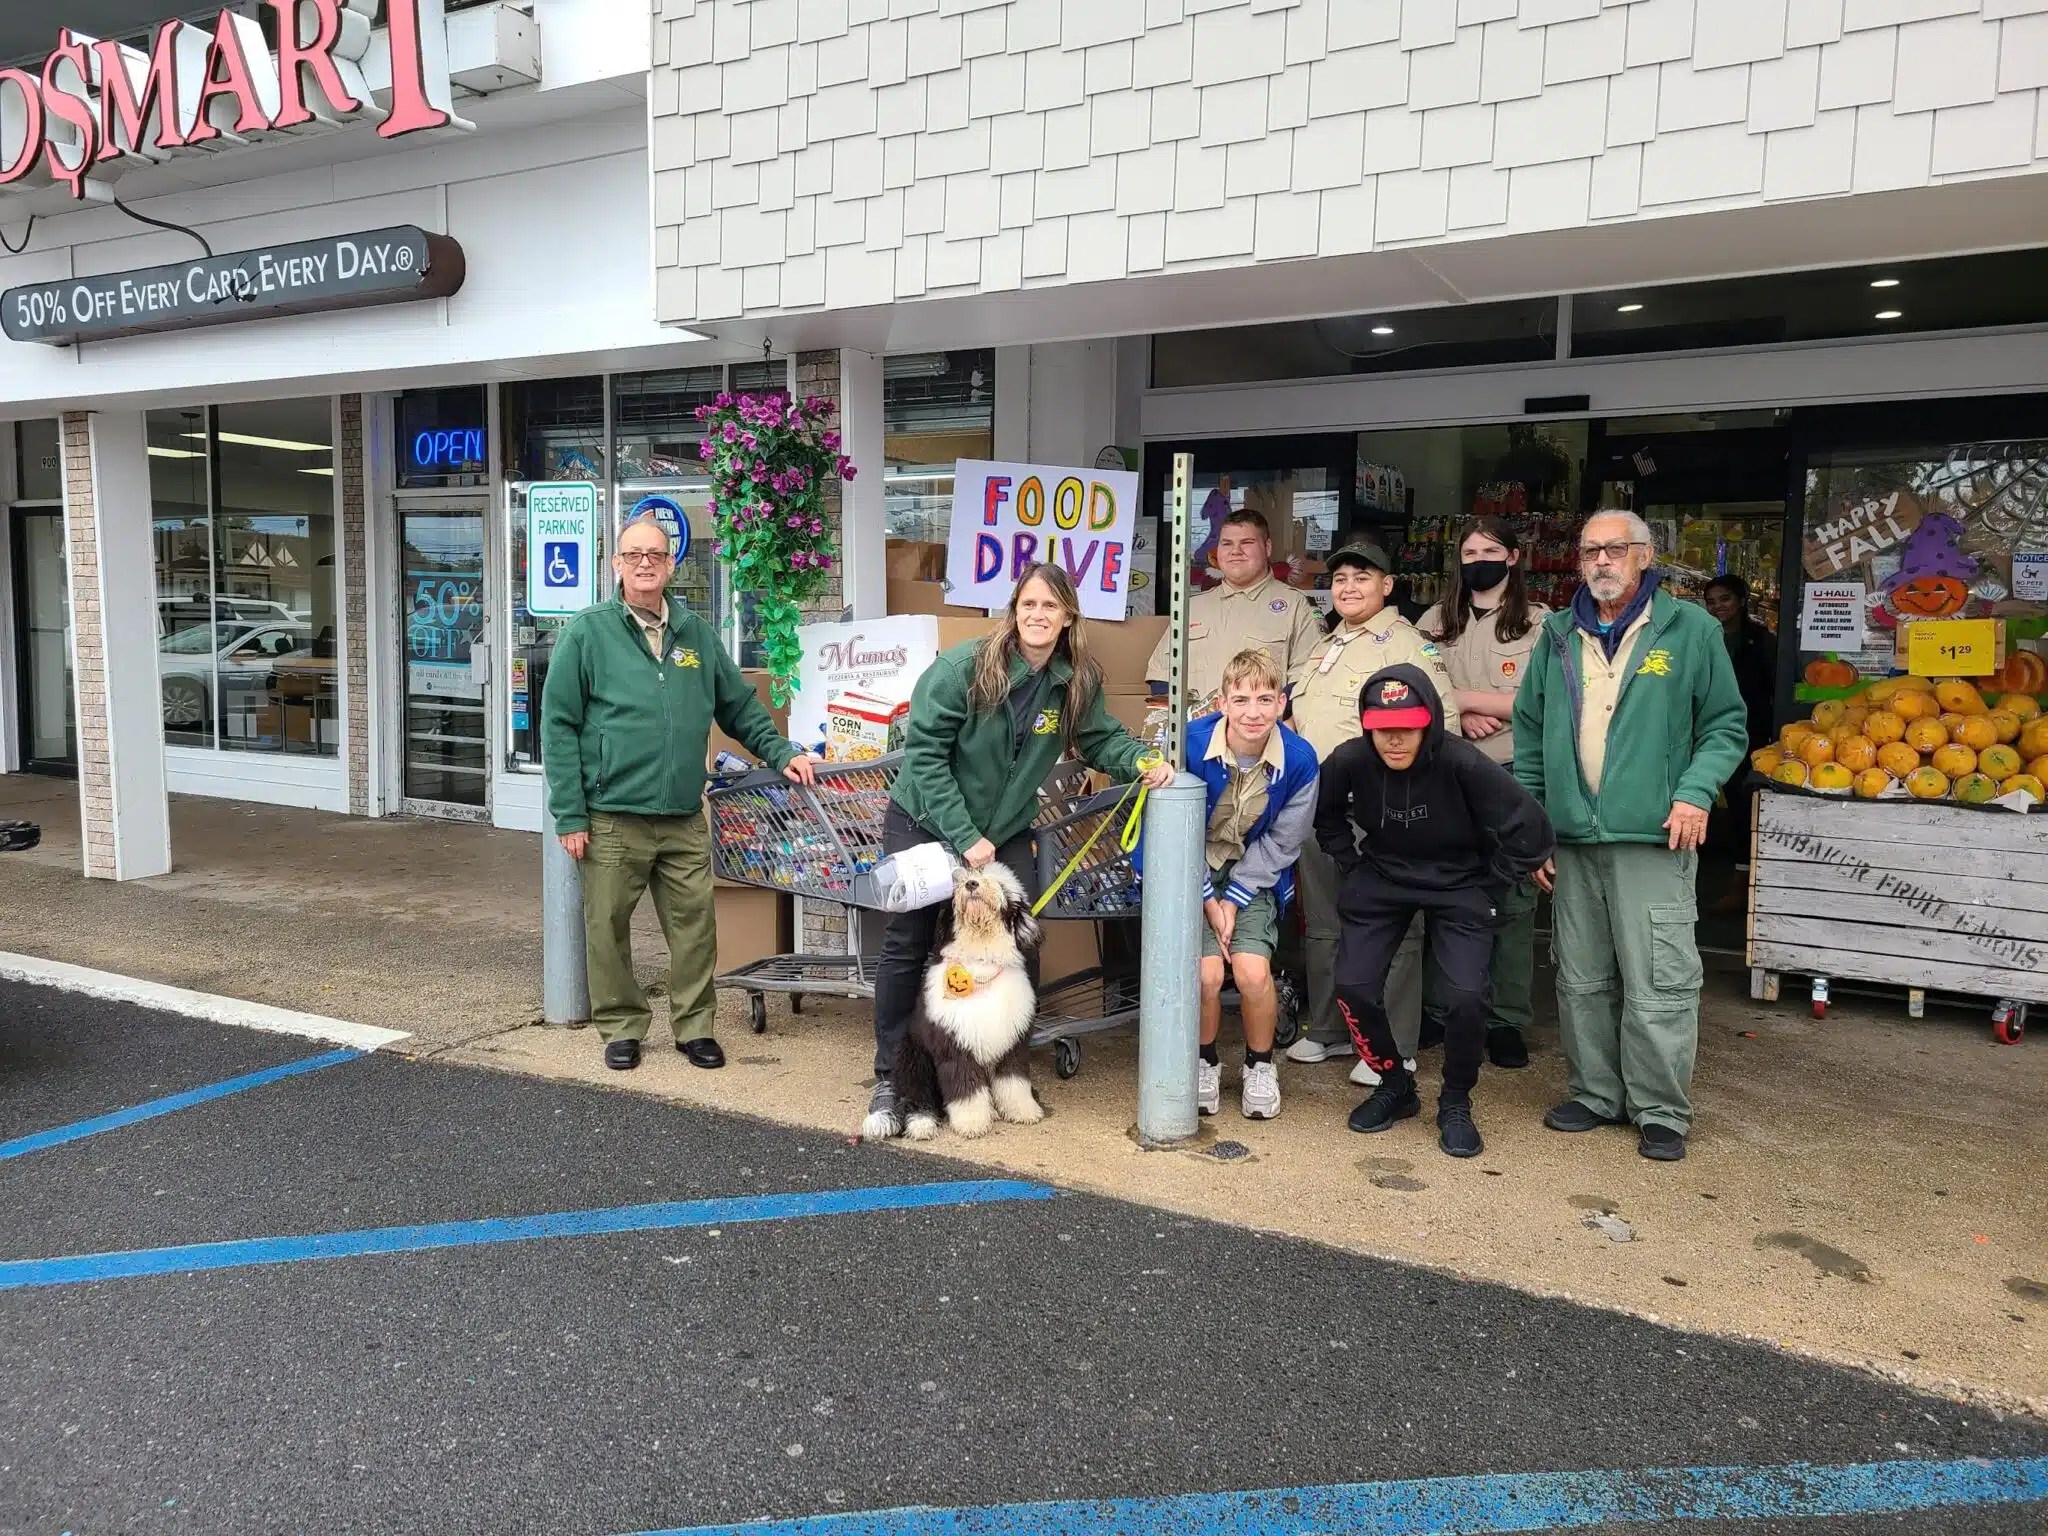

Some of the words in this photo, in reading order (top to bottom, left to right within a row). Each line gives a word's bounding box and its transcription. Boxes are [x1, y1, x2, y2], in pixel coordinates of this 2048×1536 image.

[17, 289, 67, 328] 50%
[72, 284, 117, 323] OFF
[120, 279, 182, 315] EVERY
[258, 253, 328, 292] EVERY
[415, 431, 482, 465] OPEN
[533, 497, 590, 512] RESERVED
[983, 475, 1118, 532] FOOD
[1814, 491, 1900, 545] HAPPY
[538, 520, 585, 535] PARKING
[1825, 517, 1912, 571] FALL
[974, 530, 1124, 593] DRIVE
[412, 580, 481, 626] 50%
[411, 626, 461, 659] OFF
[818, 634, 908, 672] Mama's
[832, 716, 862, 731] CORN
[833, 725, 861, 738] FLAKES
[1875, 872, 1950, 920] FRUIT
